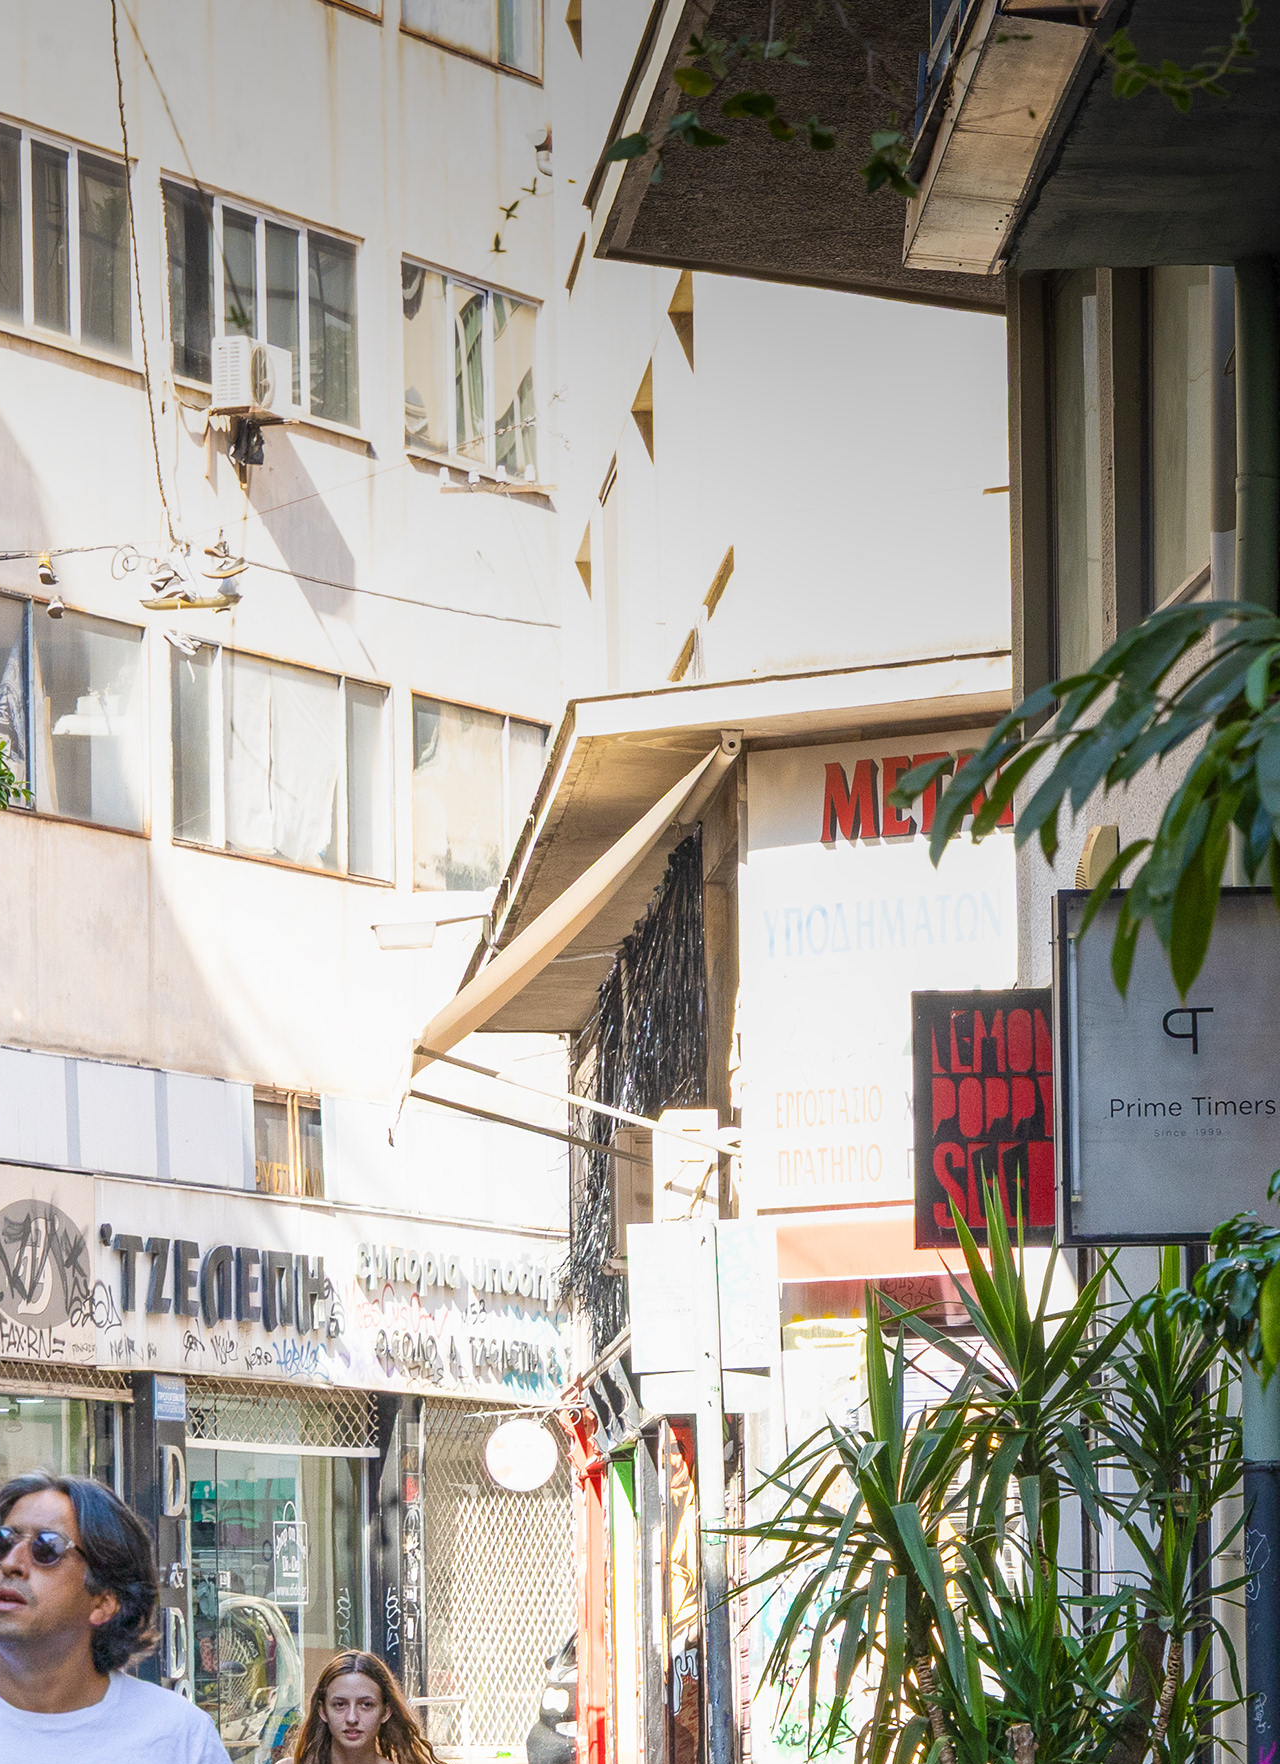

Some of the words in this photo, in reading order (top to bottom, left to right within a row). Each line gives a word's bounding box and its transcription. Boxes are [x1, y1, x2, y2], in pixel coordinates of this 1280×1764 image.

[763, 888, 1002, 959] ΥΠΟΔΗΜΑΤΩΝ
[776, 1084, 883, 1129] ΕΡΓΟΣΤΑΣΙΟ
[1110, 1098, 1182, 1118] Prime
[1191, 1096, 1276, 1116] Timers
[1154, 1129, 1187, 1138] Since
[1195, 1128, 1222, 1137] 1999
[778, 1143, 883, 1187] ΠΡΑΤΗΡΙΟ
[932, 1141, 1055, 1228] SEED
